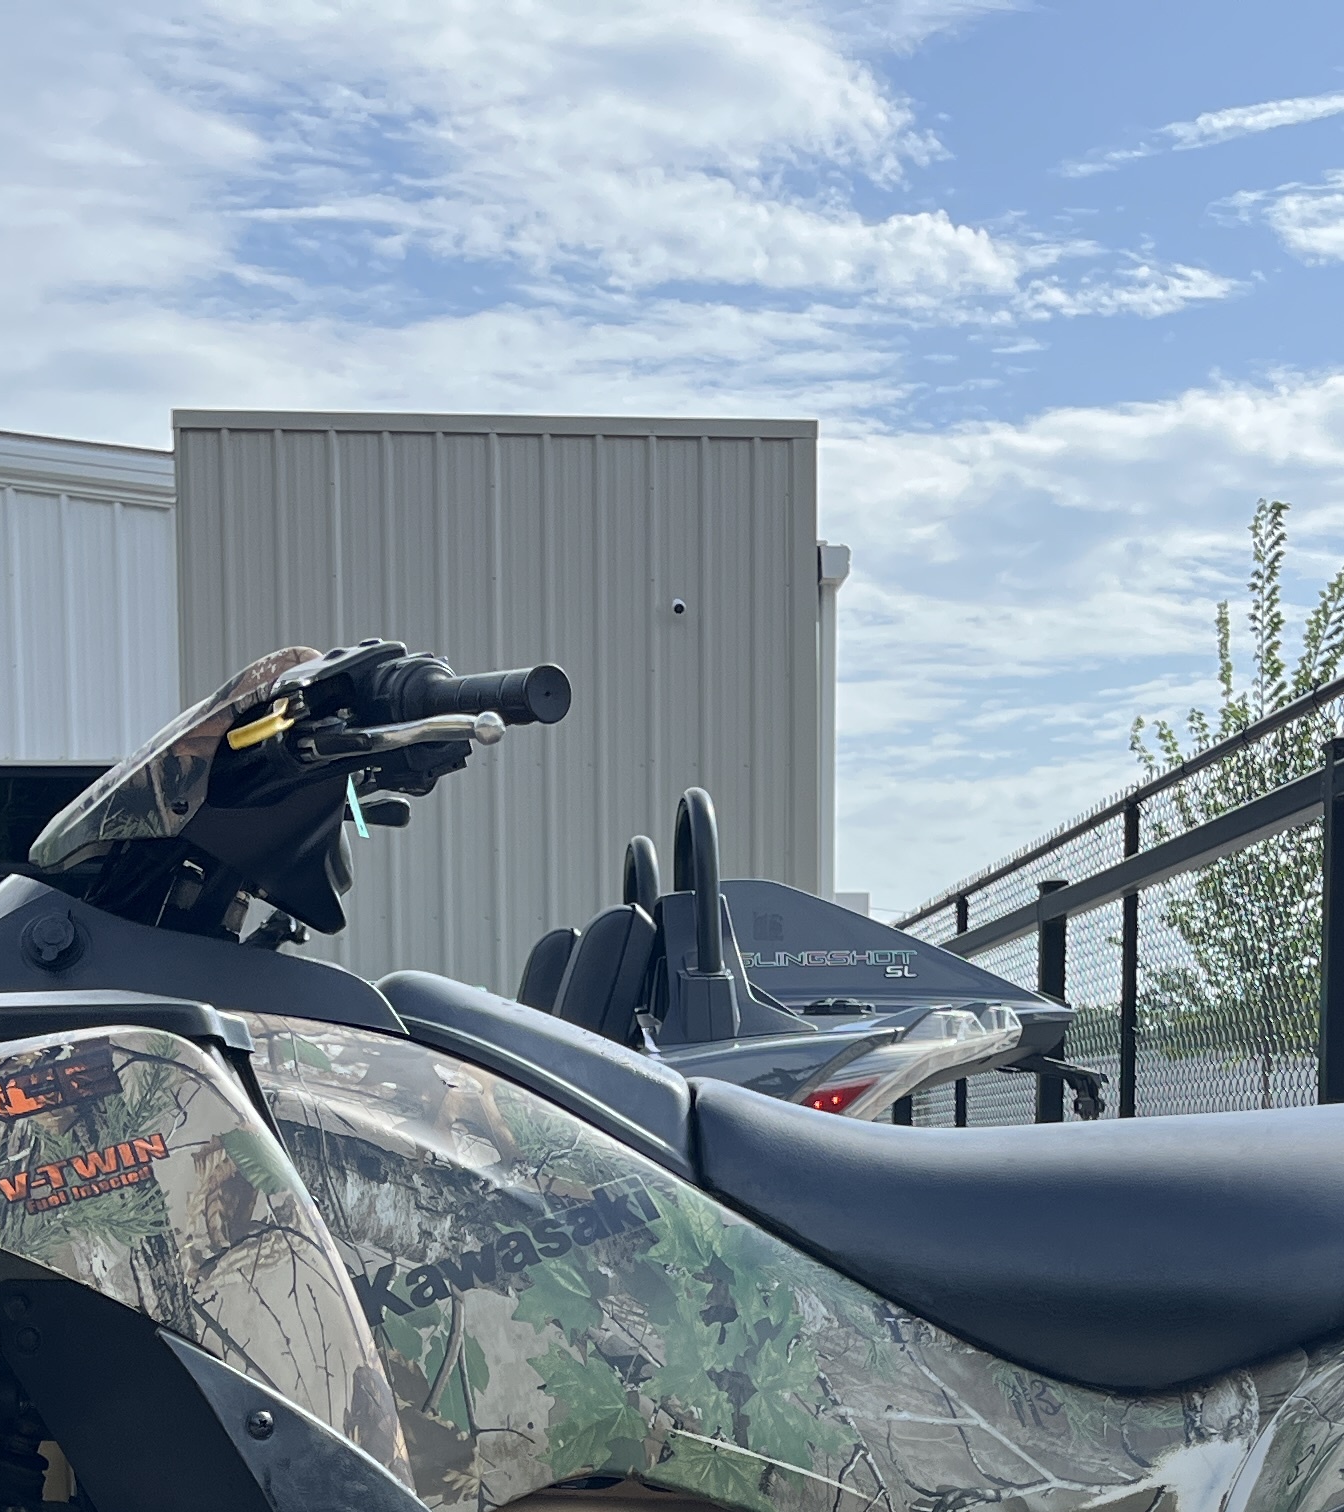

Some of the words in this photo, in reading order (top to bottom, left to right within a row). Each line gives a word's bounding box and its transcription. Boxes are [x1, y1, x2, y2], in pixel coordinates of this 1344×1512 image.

[740, 949, 918, 969] SLINGSHOT
[884, 965, 919, 979] SL
[25, 1189, 71, 1216] Fuel
[70, 1165, 156, 1201] Injected
[354, 1186, 662, 1328] Kawasaki
